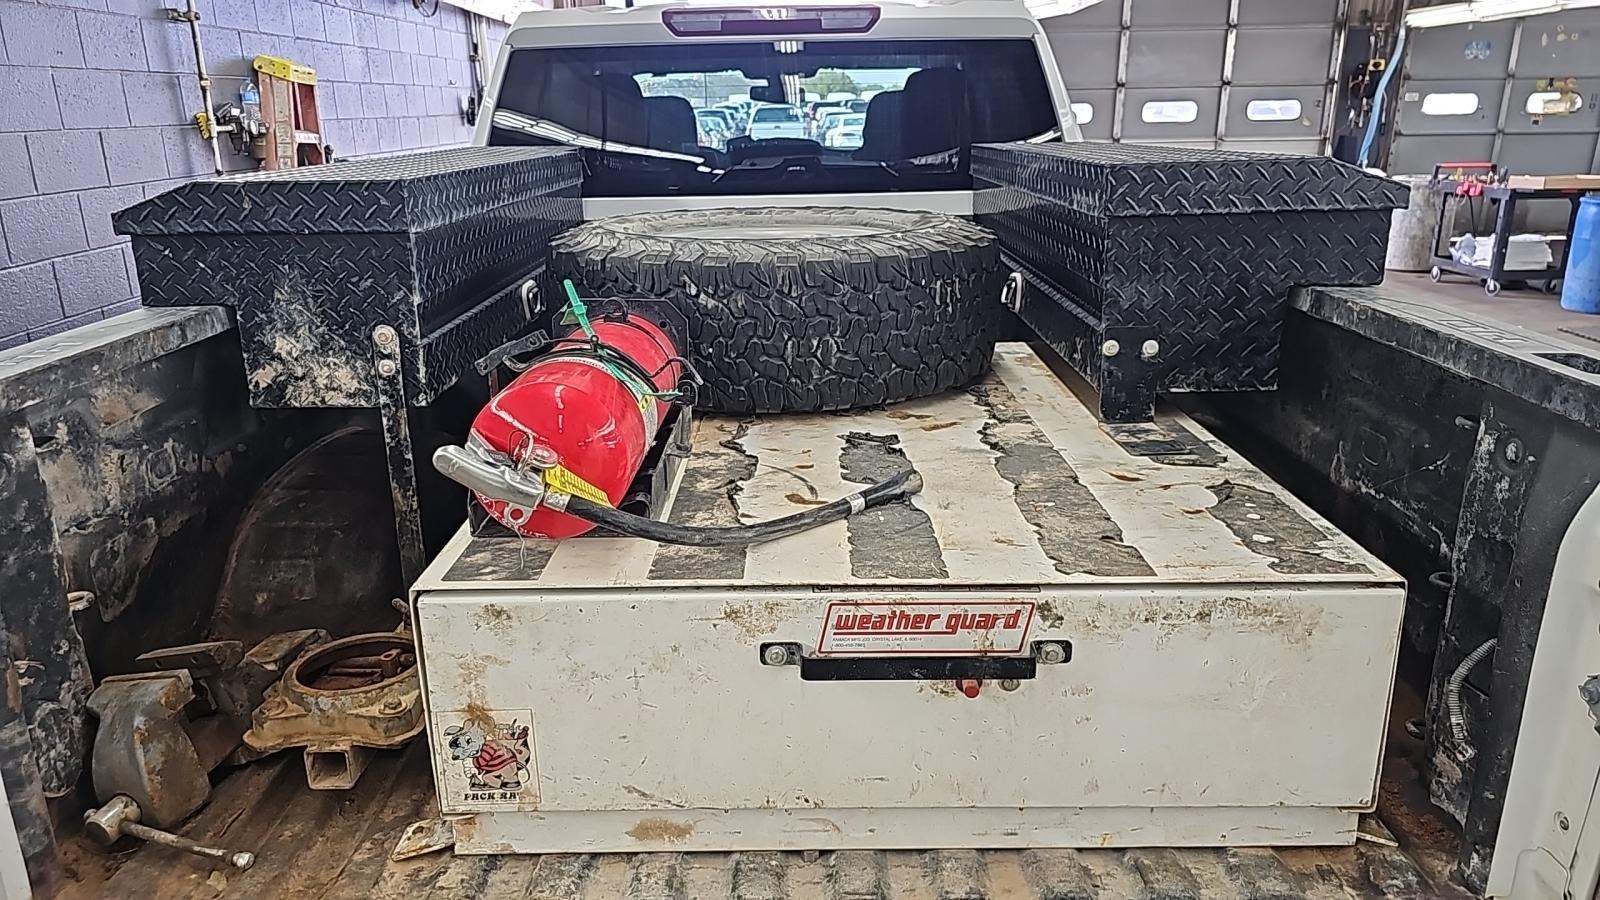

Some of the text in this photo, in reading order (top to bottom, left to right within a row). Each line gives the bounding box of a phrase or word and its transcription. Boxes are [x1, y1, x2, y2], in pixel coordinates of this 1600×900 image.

[835, 609, 1022, 633] weather guard
[464, 792, 495, 801] PACK
